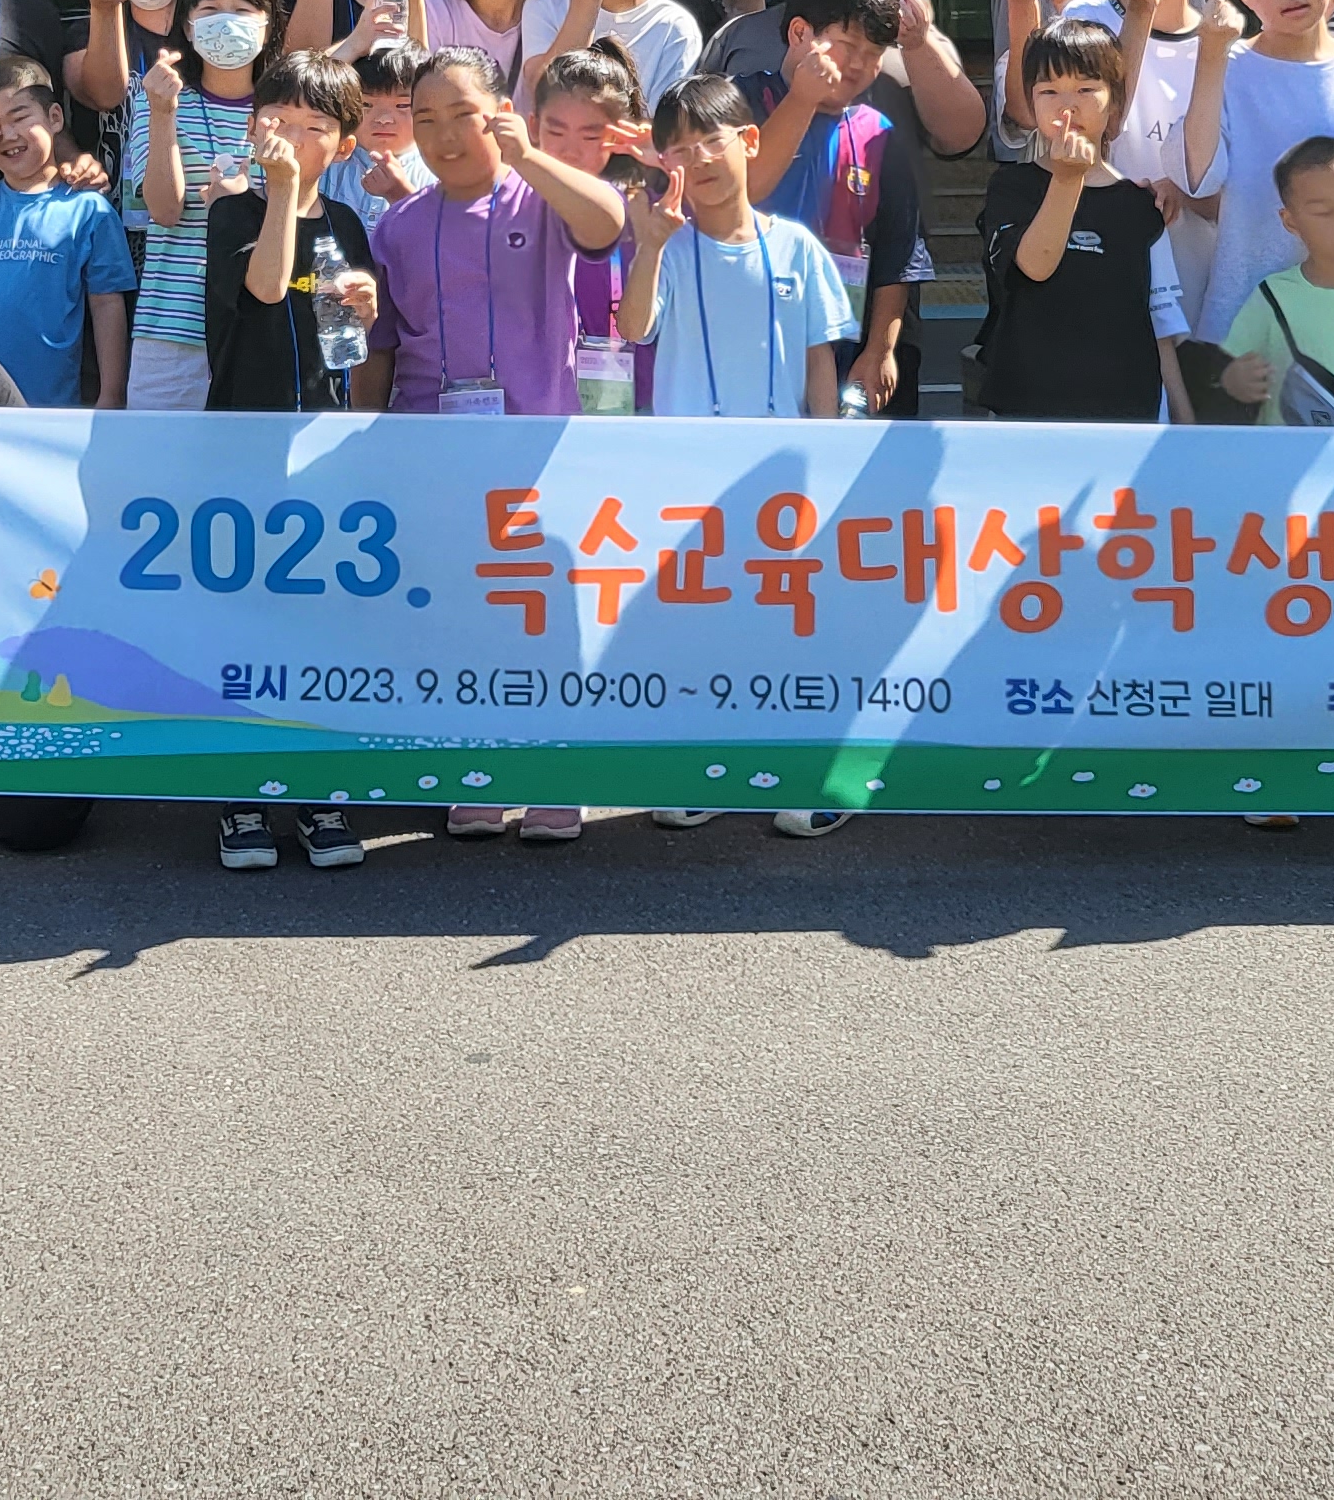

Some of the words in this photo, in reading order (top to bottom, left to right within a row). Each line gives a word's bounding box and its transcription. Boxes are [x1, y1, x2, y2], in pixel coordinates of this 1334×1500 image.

[119, 496, 432, 609] 2023.
[220, 663, 288, 702] 일시
[299, 666, 403, 703] 2023.
[416, 668, 444, 704] 9.
[456, 668, 548, 708] 8.(금)
[560, 671, 667, 709] 09:00
[709, 674, 737, 710] 9.
[749, 673, 840, 713] 9.(토)
[851, 676, 951, 714] 14:00
[1005, 678, 1075, 716] 장소
[1086, 679, 1192, 717] 산청군
[1205, 680, 1273, 718] 일대
